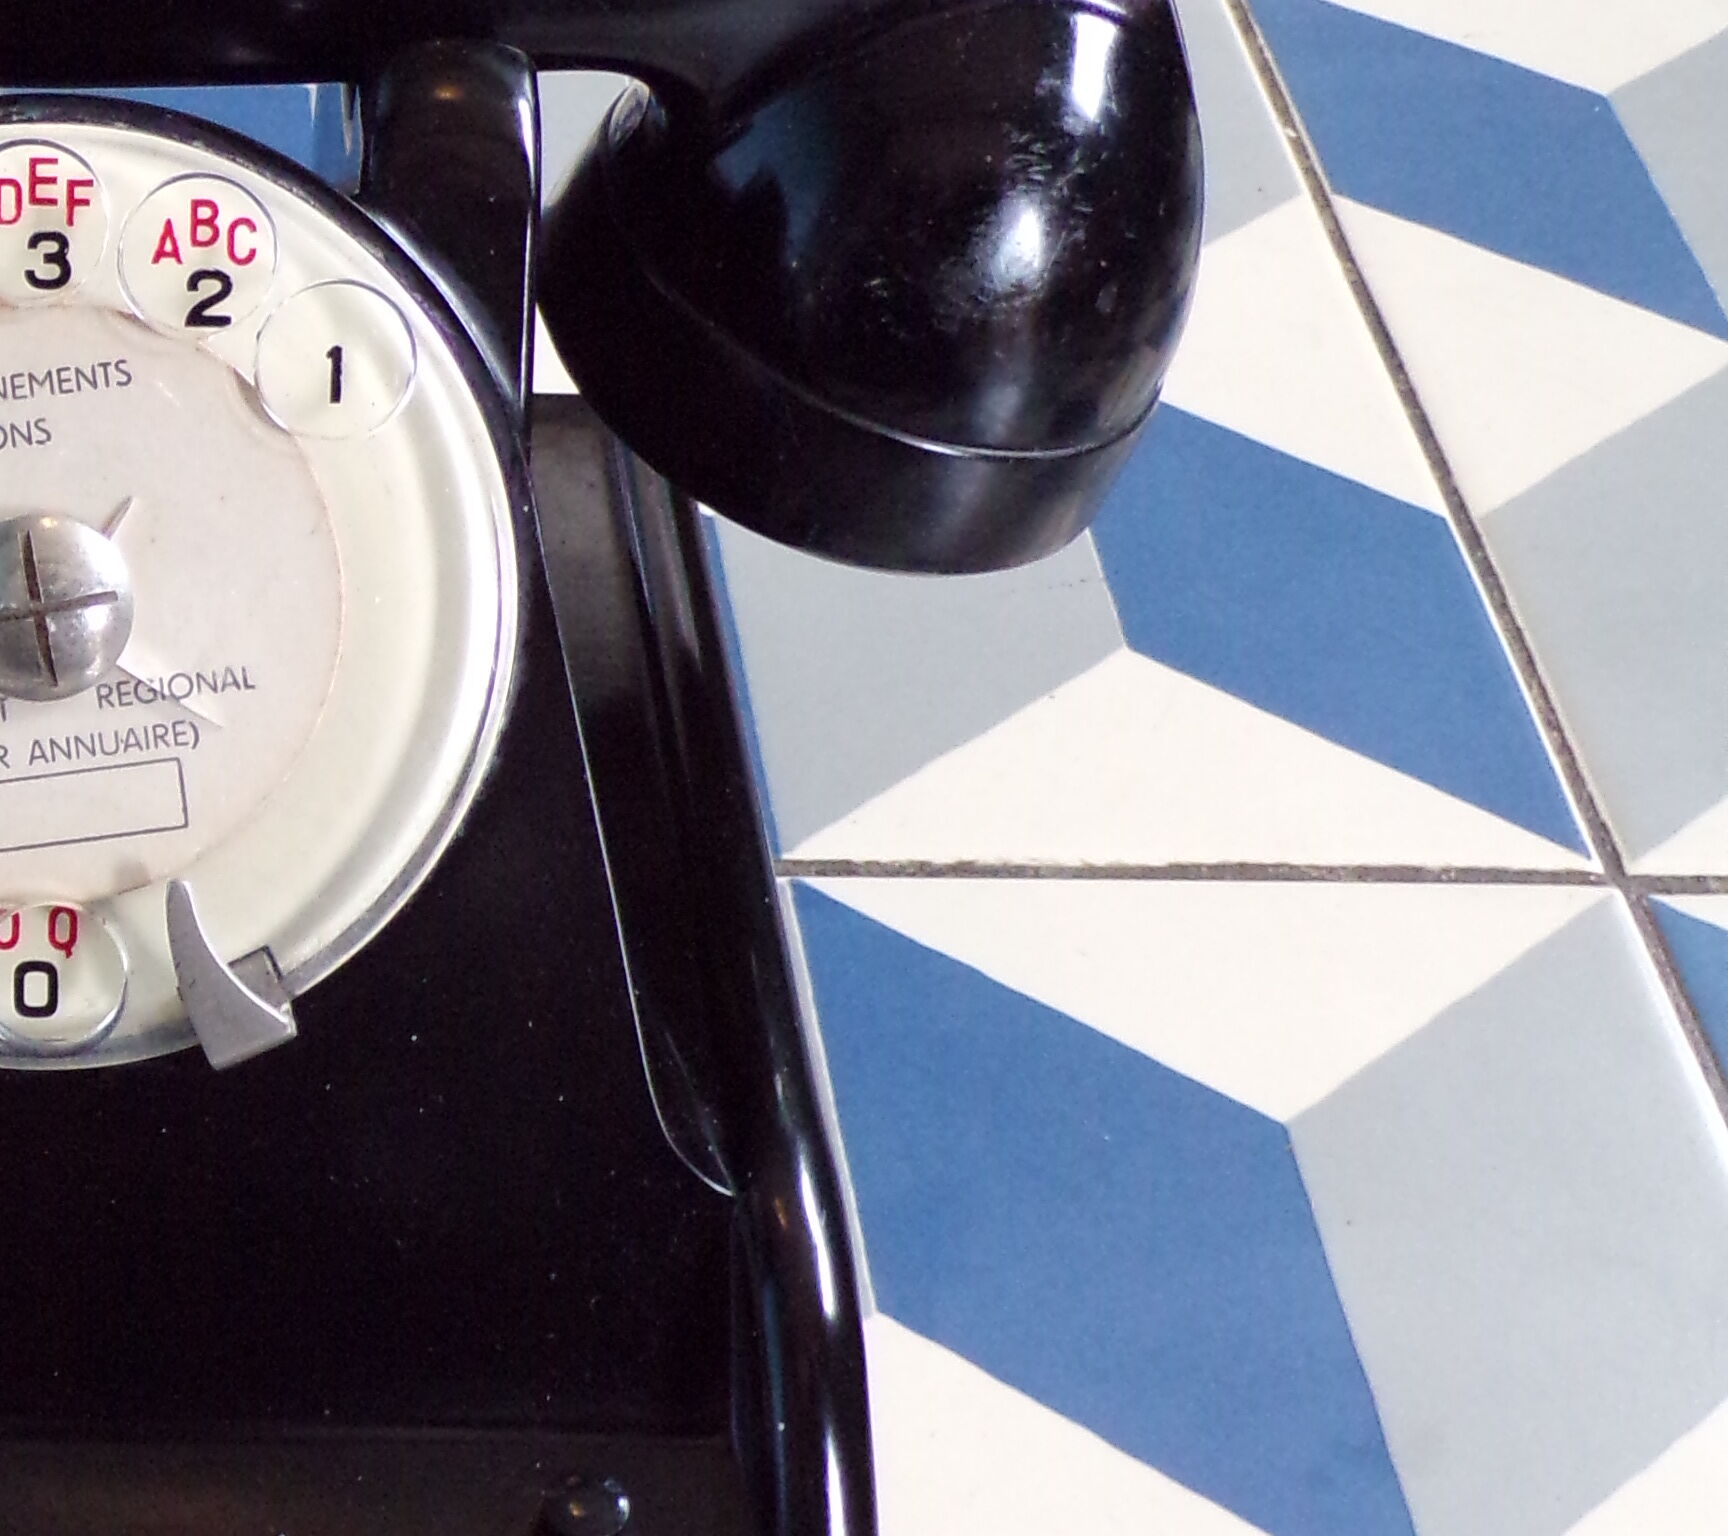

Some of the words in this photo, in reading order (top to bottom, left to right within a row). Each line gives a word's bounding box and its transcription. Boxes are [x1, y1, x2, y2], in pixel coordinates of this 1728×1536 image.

[24, 230, 72, 290] 3
[152, 198, 257, 266] ABC
[185, 268, 233, 327] 2
[325, 345, 344, 404] 1
[96, 666, 257, 710] REGIONAL
[28, 720, 200, 767] ANNUAIRE)
[13, 960, 58, 1018] 0
